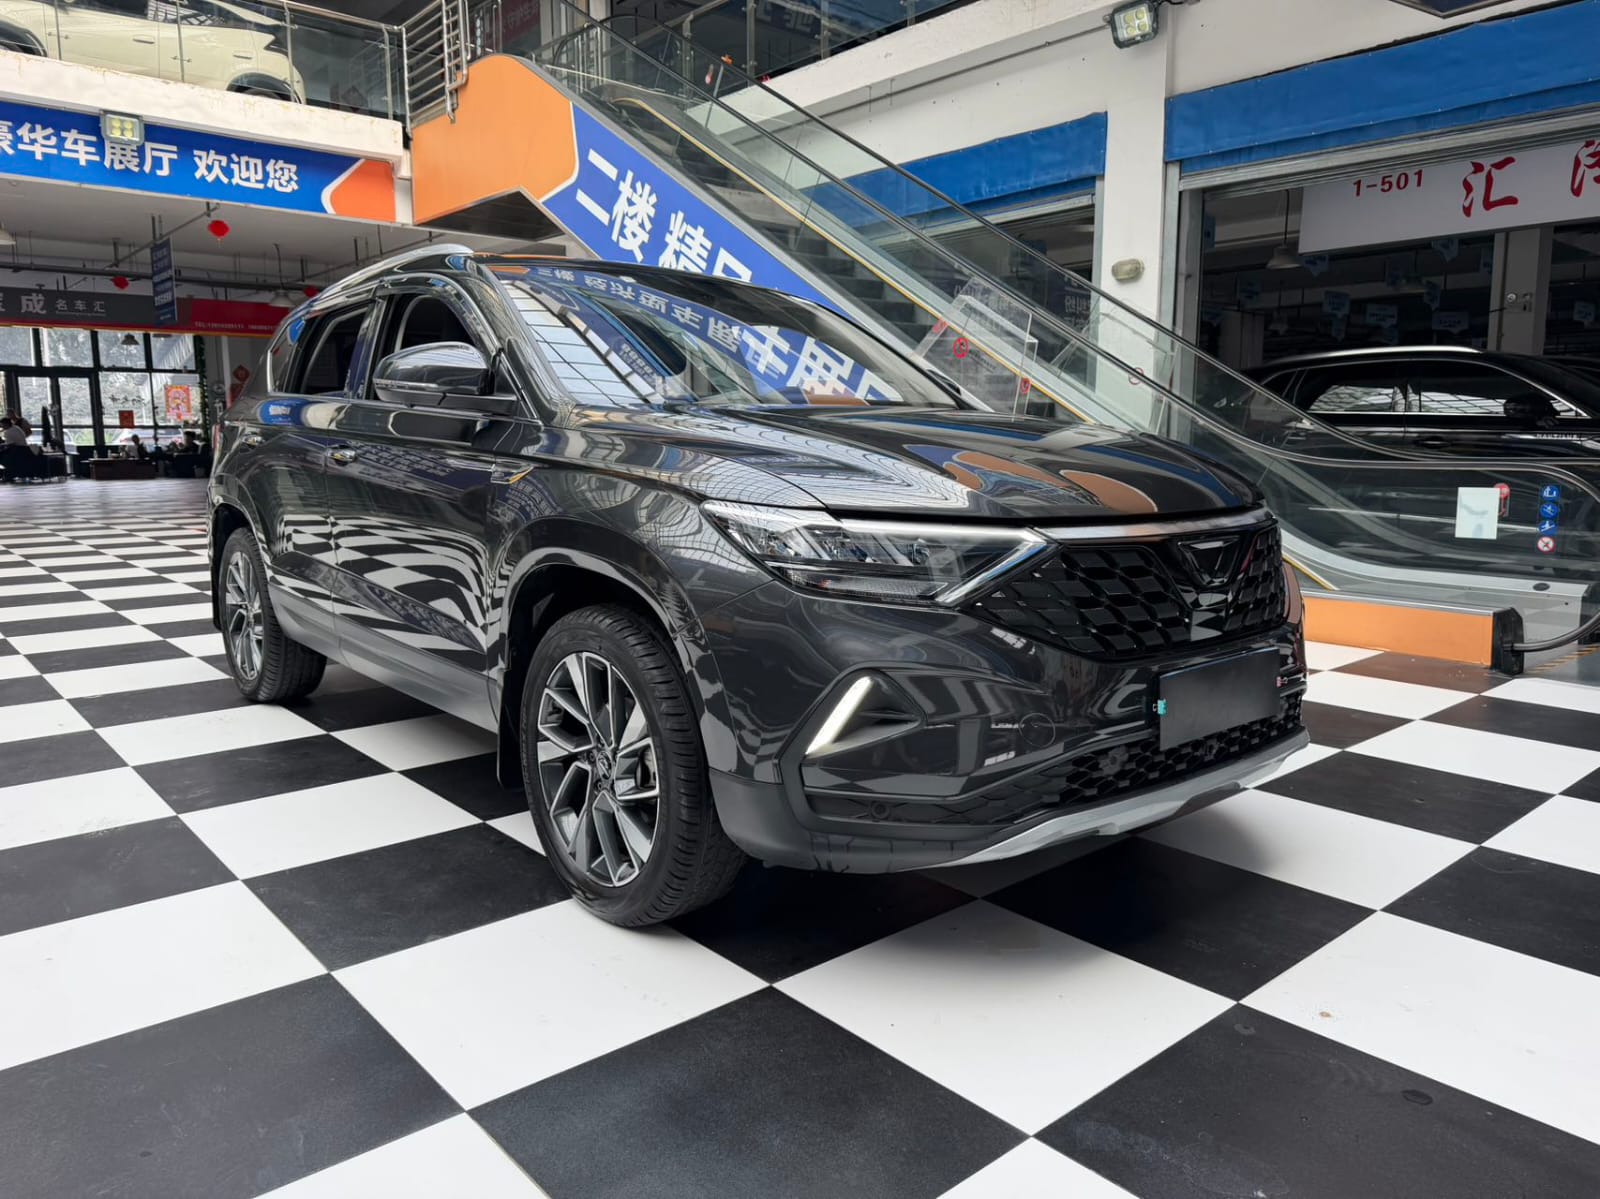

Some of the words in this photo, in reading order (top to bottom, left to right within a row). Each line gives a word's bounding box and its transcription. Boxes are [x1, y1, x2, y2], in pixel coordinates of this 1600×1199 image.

[193, 148, 299, 193] 欢迎您
[1353, 169, 1424, 197] 1-501
[576, 148, 658, 262] 二楼
[56, 299, 105, 313] 名车汇
